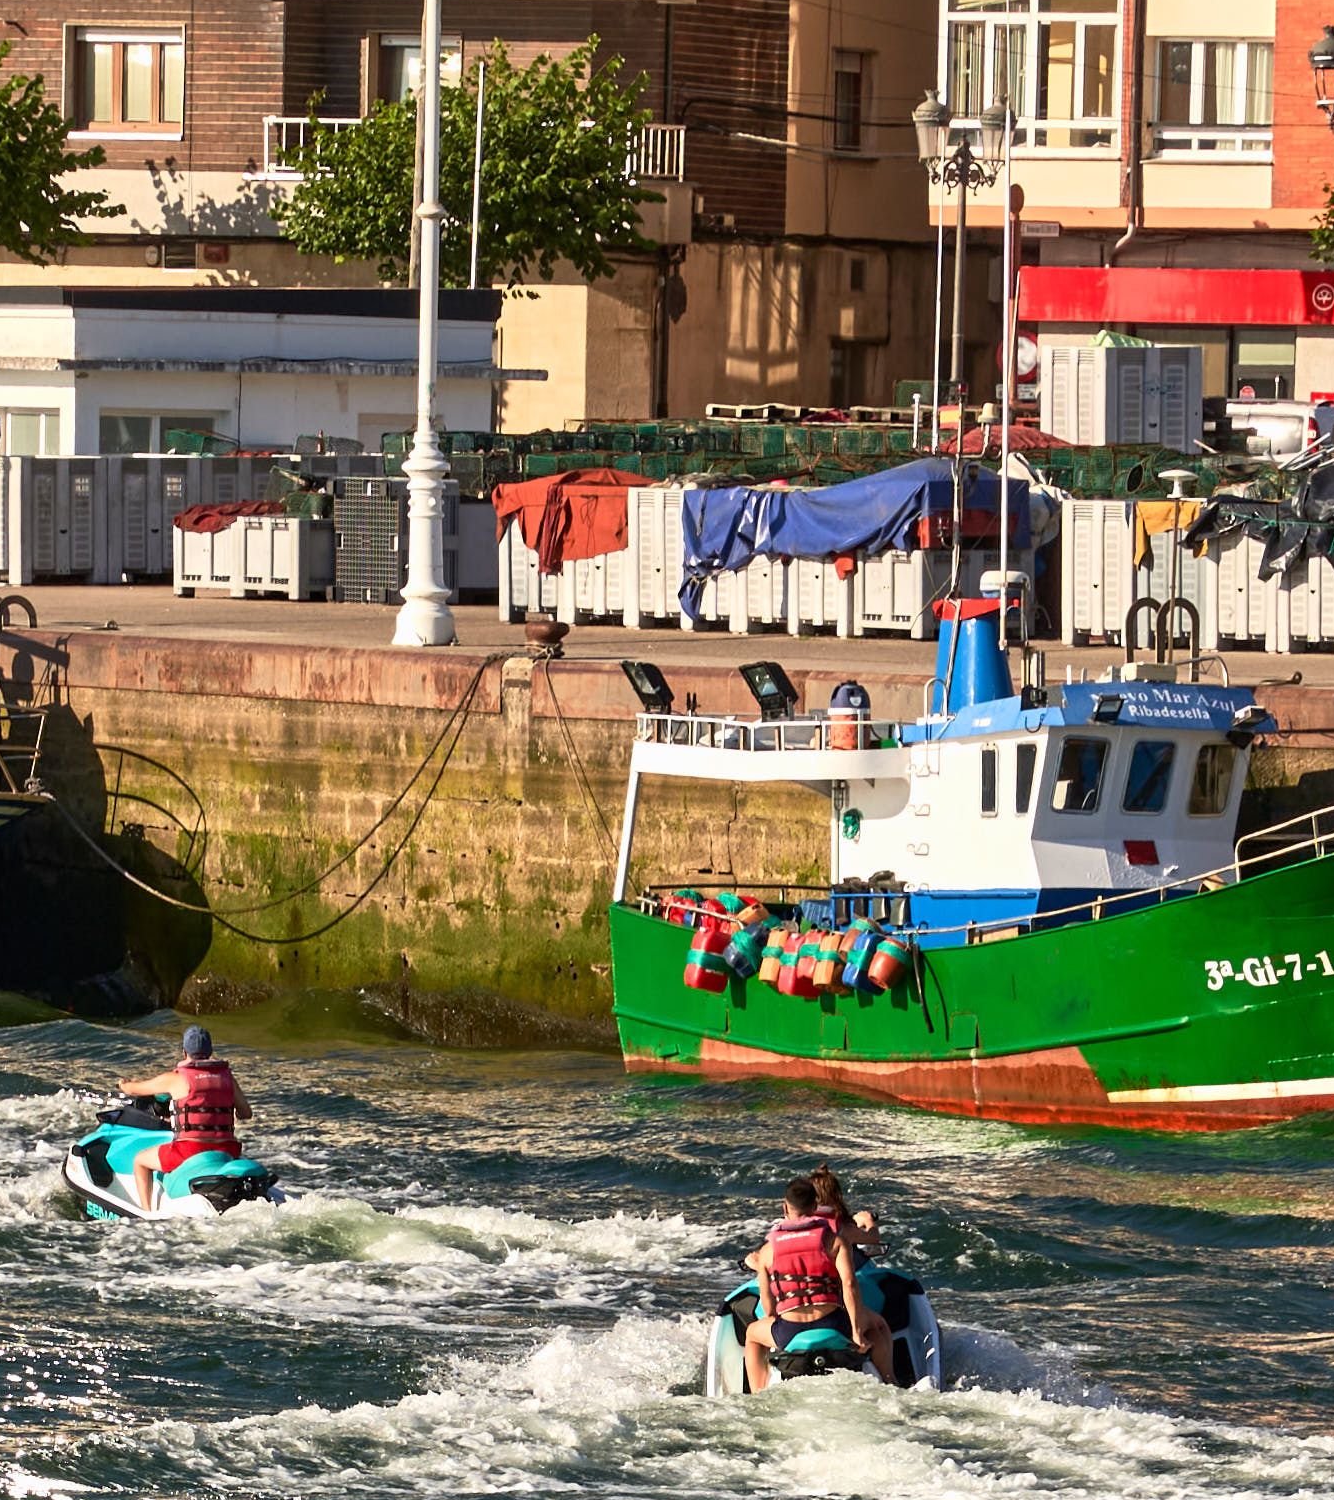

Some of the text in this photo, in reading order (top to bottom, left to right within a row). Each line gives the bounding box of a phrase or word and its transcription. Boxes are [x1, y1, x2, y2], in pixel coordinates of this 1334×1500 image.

[1152, 688, 1191, 705] Mar
[1196, 693, 1237, 713] Azul
[1127, 704, 1211, 720] Ribadesella
